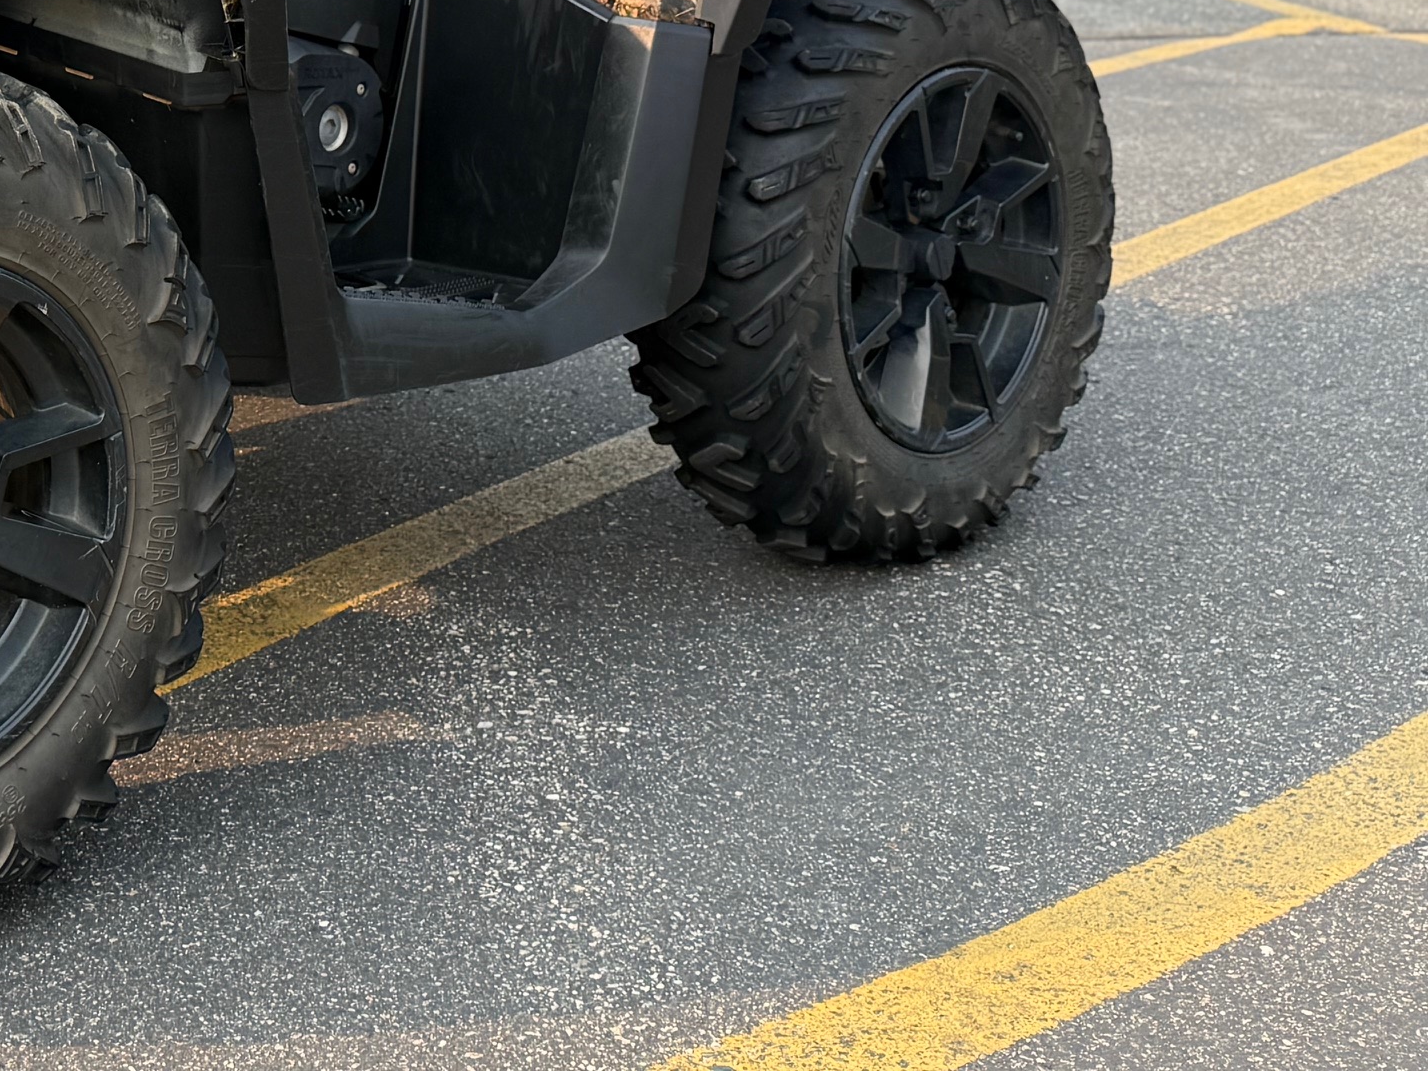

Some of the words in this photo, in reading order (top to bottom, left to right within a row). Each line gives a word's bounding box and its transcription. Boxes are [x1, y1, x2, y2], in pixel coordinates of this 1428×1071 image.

[39, 241, 59, 257] FOR
[92, 287, 113, 311] ONLY
[145, 392, 180, 506] TERRA
[125, 515, 179, 635] CROSS
